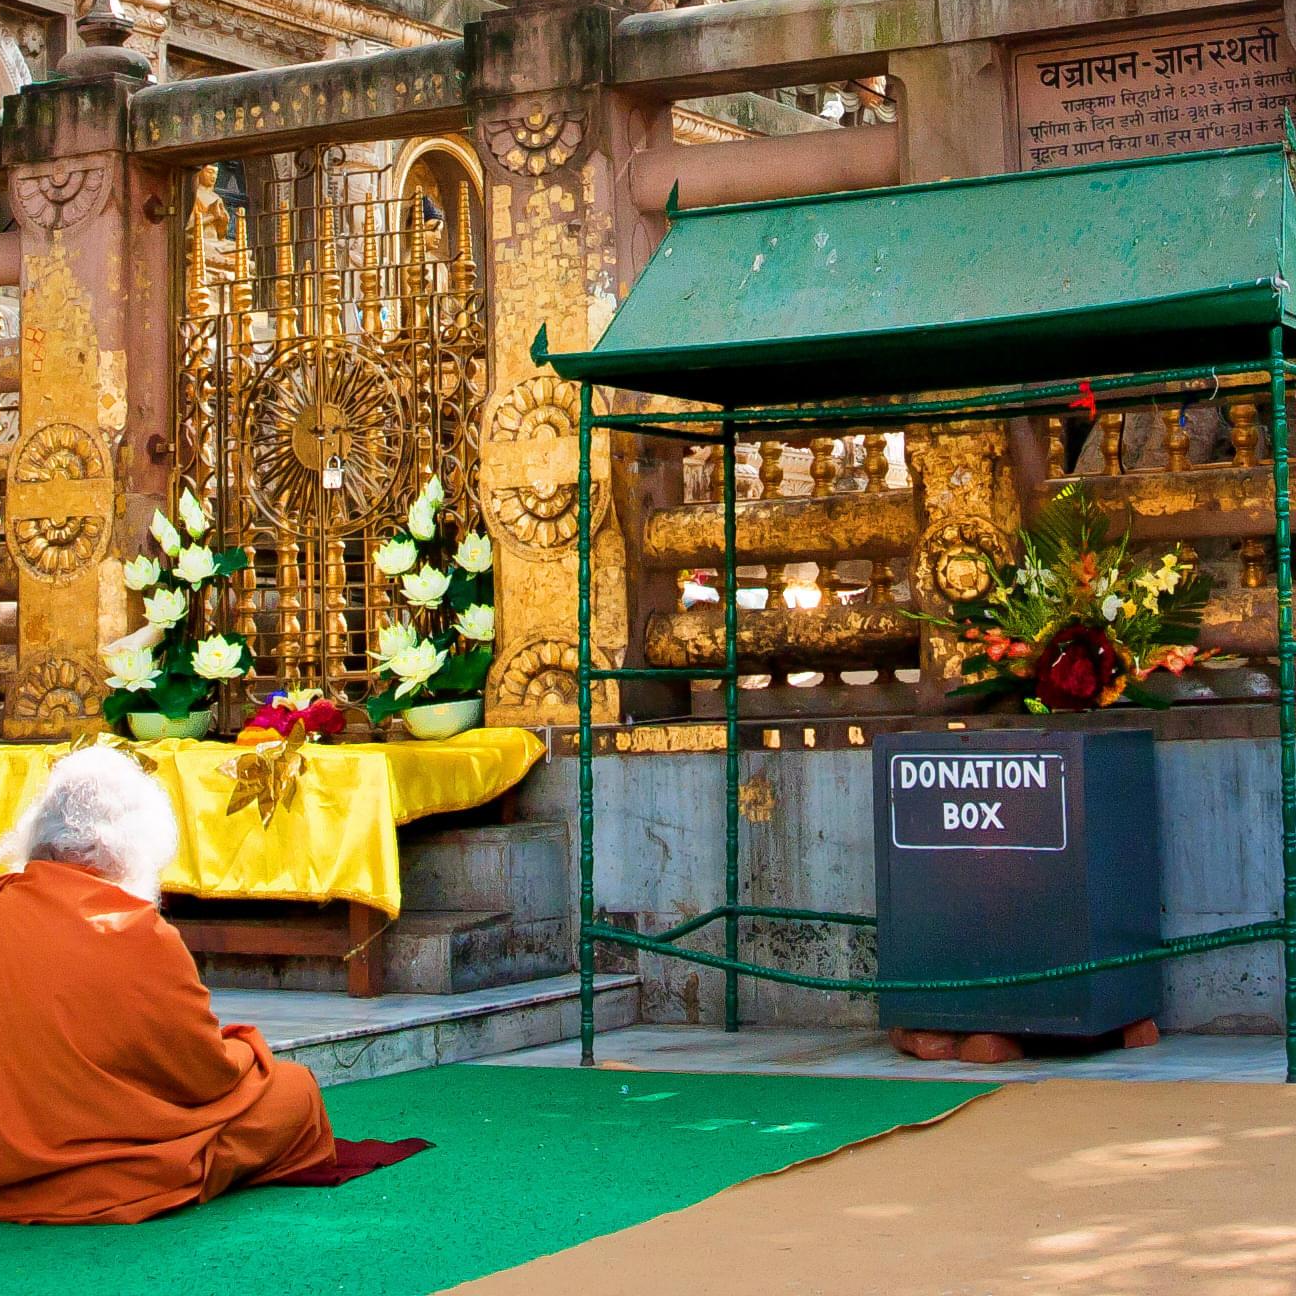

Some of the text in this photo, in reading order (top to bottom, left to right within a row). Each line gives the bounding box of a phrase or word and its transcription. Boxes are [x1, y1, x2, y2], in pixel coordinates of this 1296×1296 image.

[1207, 26, 1280, 69] स्थली
[1061, 95, 1116, 115] राजकुमार
[1162, 82, 1176, 100] ने
[1072, 116, 1088, 133] के
[1091, 115, 1115, 133] दिन
[1117, 109, 1144, 130] इसी
[1210, 99, 1225, 117] के
[1072, 140, 1105, 157] प्राप्त
[1106, 135, 1142, 151] किया
[1165, 130, 1192, 149] इस
[1254, 116, 1269, 132] के
[900, 760, 1047, 789] DONATION
[943, 802, 1005, 830] BOX
